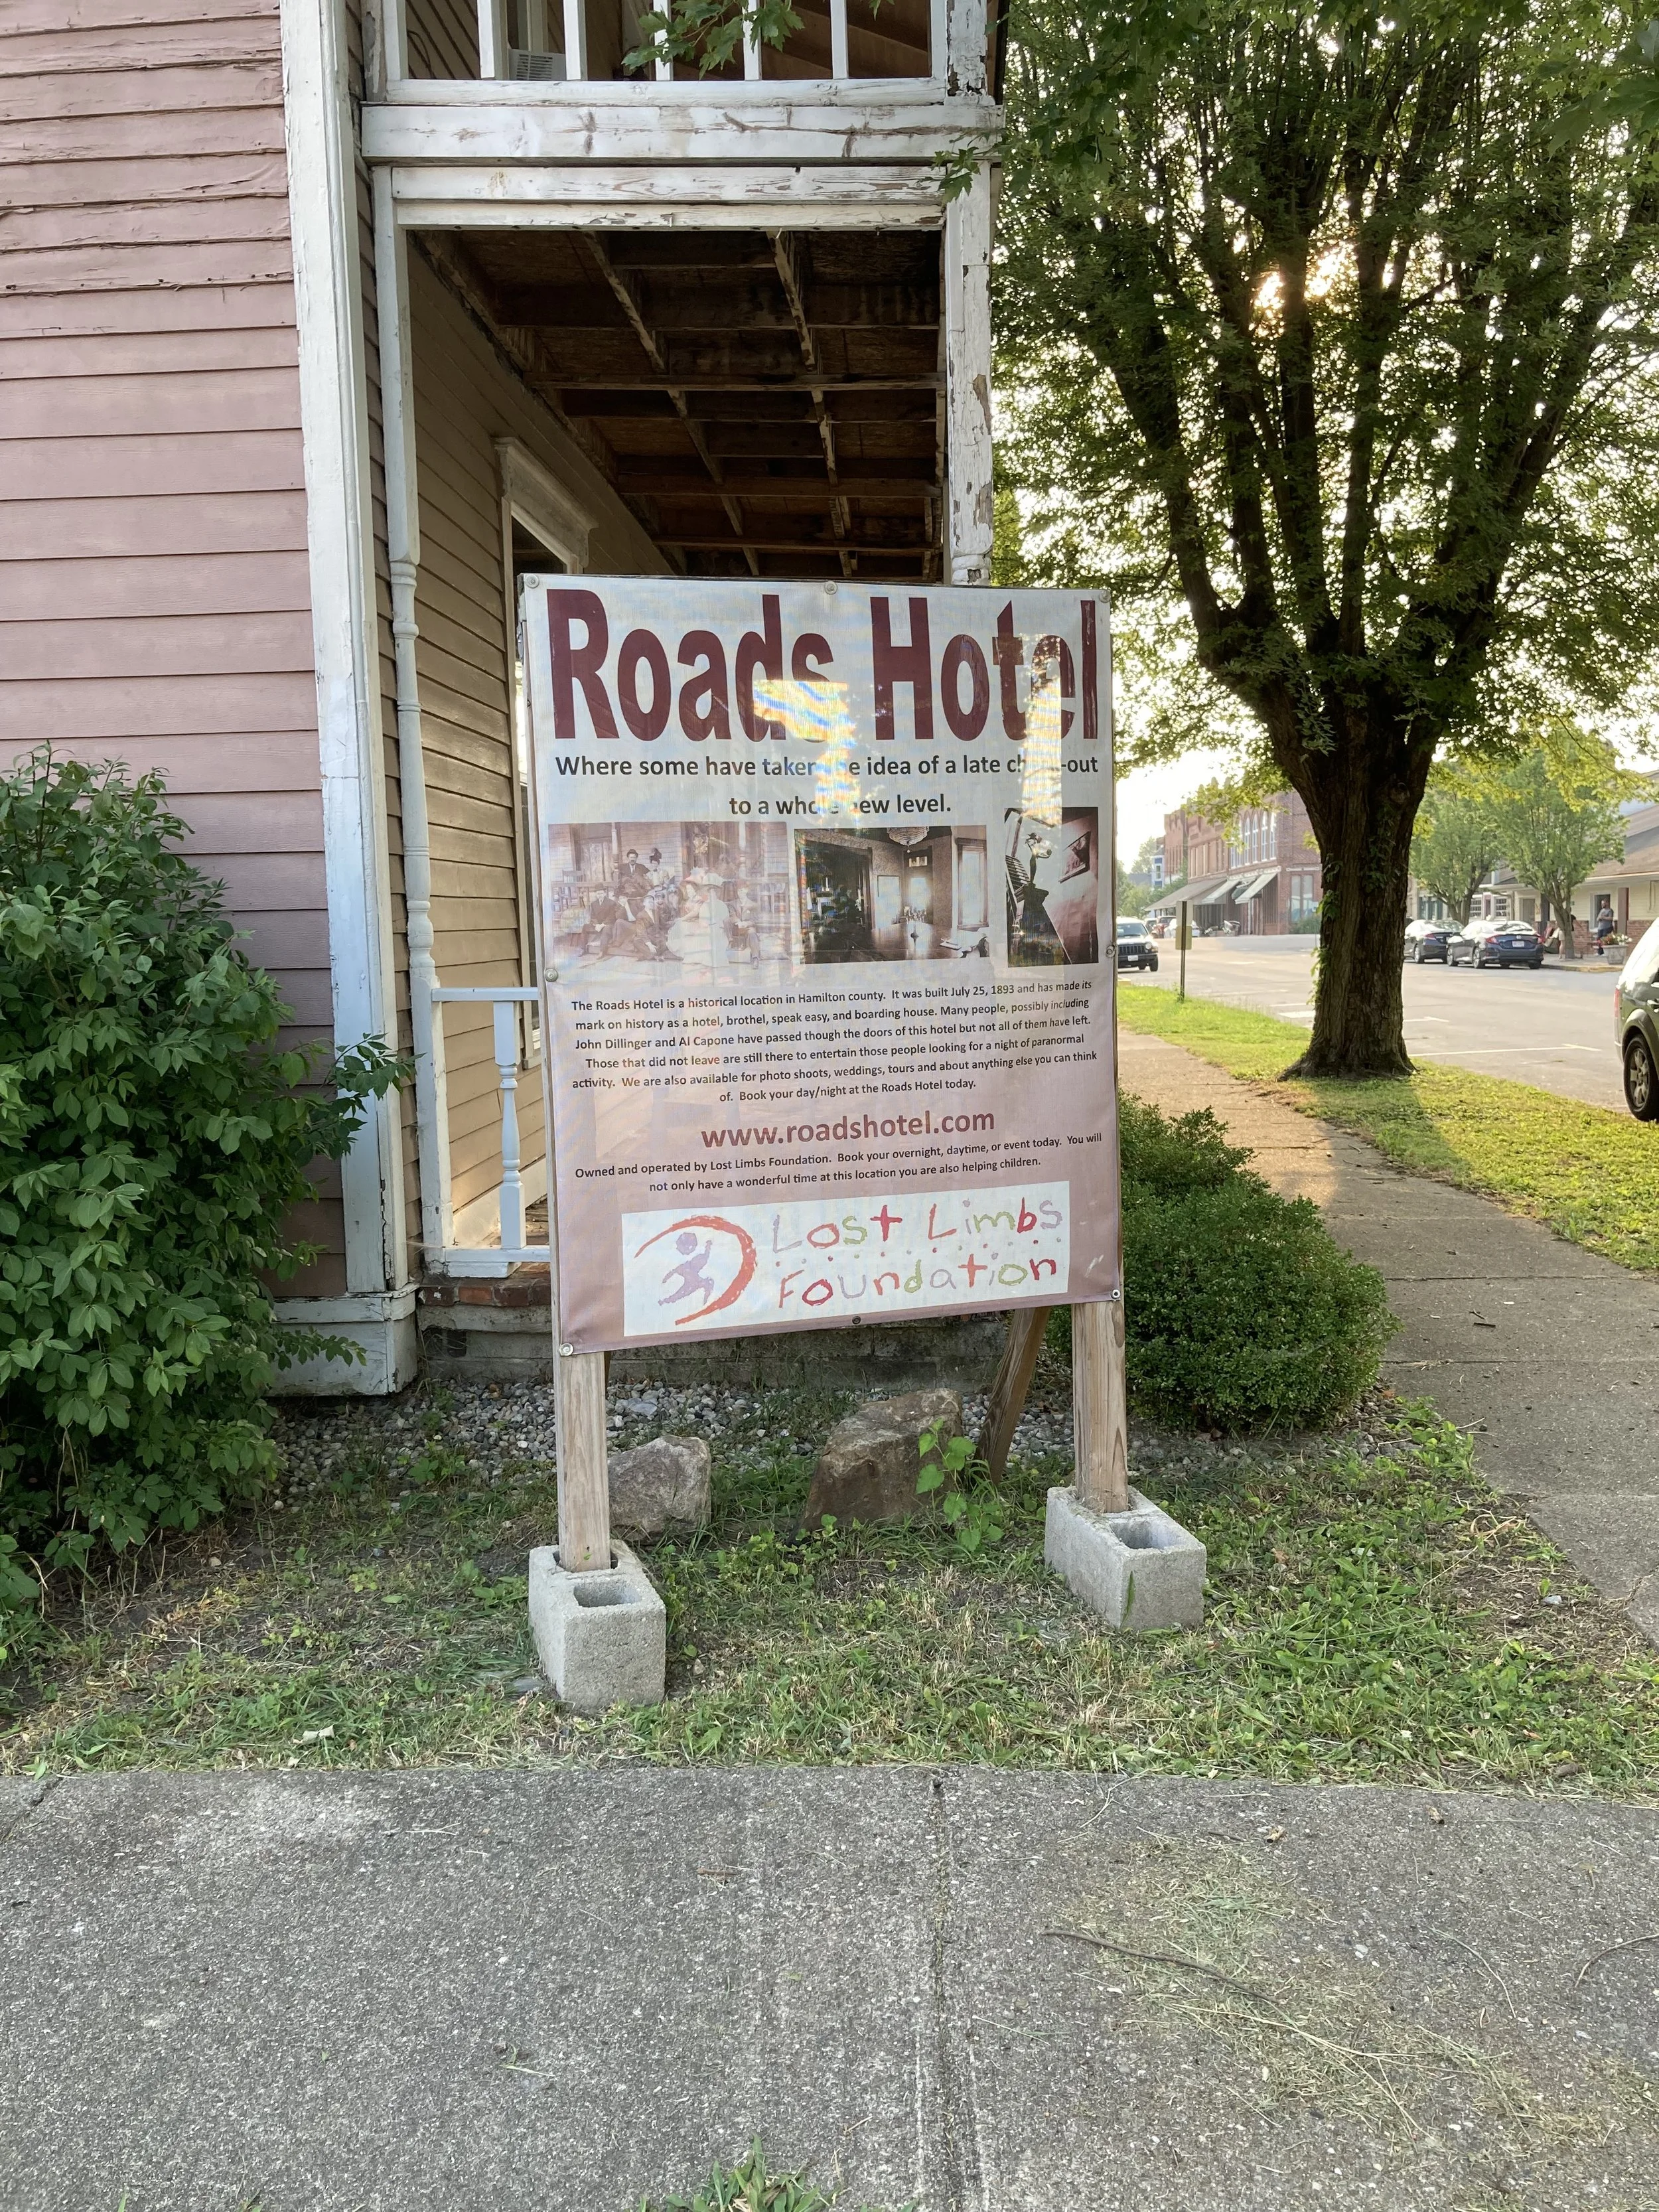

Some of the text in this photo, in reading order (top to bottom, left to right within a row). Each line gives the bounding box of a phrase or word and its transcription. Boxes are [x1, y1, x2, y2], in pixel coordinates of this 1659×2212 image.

[870, 596, 1098, 741] Hotel
[555, 755, 632, 775] Where
[639, 759, 699, 775] some
[705, 755, 756, 775] have
[867, 755, 911, 775] idea
[918, 755, 939, 774] of
[945, 760, 956, 774] a
[964, 754, 1001, 773] late
[1007, 754, 1099, 773] ch-out
[729, 798, 751, 815] to
[758, 800, 770, 815] a
[847, 798, 890, 814] ew
[897, 793, 952, 813] level.
[571, 1001, 593, 1011] The
[596, 999, 630, 1010] Roads
[634, 999, 664, 1009] Hotel
[666, 999, 676, 1009] is
[688, 995, 737, 1007] historical
[741, 995, 783, 1005] location
[786, 994, 795, 1003] in
[798, 992, 845, 1003] Hamilton
[848, 991, 886, 1002] county.
[892, 990, 900, 999] It
[925, 987, 948, 997] built
[950, 986, 970, 998] July
[973, 986, 988, 997] 25,
[991, 984, 1015, 995] 1893
[1017, 982, 1035, 994] and
[1037, 982, 1053, 992] has
[1056, 980, 1080, 991] made
[1082, 981, 1092, 990] its
[575, 1019, 605, 1030] mark
[625, 1019, 664, 1031] history
[692, 1015, 723, 1027] hotel,
[727, 1013, 769, 1025] brothel,
[772, 1012, 802, 1025] speak
[804, 1013, 830, 1023] easy,
[832, 1010, 851, 1021] and
[855, 1008, 901, 1020] boarding
[903, 1007, 938, 1017] house.
[940, 1005, 969, 1017] Many
[972, 1003, 1008, 1016] people,
[1011, 1000, 1049, 1014] possibly
[1051, 997, 1090, 1009] including
[575, 1015, 1091, 1050] John Dillinger and Al Capone have passed though the doors of this hotel but not all of them have left.
[585, 1058, 619, 1069] Those
[622, 1057, 646, 1068] that
[648, 1056, 666, 1067] did
[670, 1057, 688, 1066] not
[691, 1055, 720, 1065] leave
[743, 1052, 762, 1063] still
[764, 1051, 794, 1062] there
[796, 1051, 807, 1060] to
[810, 1047, 857, 1059] entertain
[859, 1047, 888, 1057] those
[891, 1044, 926, 1057] people
[929, 1042, 966, 1053] looking
[968, 1041, 983, 1051] for
[994, 1039, 1019, 1051] night
[1021, 1037, 1031, 1048] of
[1031, 1033, 1084, 1049] paranormal
[572, 1077, 615, 1089] activity.
[621, 1077, 640, 1086] We
[664, 1074, 687, 1086] also
[690, 1072, 739, 1084] available
[741, 1072, 757, 1082] for
[759, 1070, 791, 1083] photo
[794, 1069, 831, 1079] shoots,
[833, 1065, 885, 1076] weddings,
[887, 1065, 914, 1074] tours
[917, 1061, 936, 1072] and
[939, 1061, 970, 1071] about
[972, 1058, 1013, 1070] anything
[1015, 1056, 1033, 1066] else
[1035, 1056, 1051, 1066] you
[1072, 1051, 1097, 1061] think
[719, 1078, 976, 1102] of. Book your day/night at the Roads Hotel today.
[701, 1110, 995, 1148] www.roadshotel.com
[575, 1165, 615, 1178] Owned
[618, 1163, 638, 1175] and
[640, 1161, 691, 1175] operated
[694, 1161, 707, 1173] by
[710, 1161, 733, 1171] Lost
[735, 1157, 766, 1169] Limbs
[769, 1154, 831, 1167] Foundation.
[837, 1151, 864, 1162] Book
[866, 1151, 890, 1163] your
[893, 1146, 944, 1159] overnight,
[946, 1144, 989, 1156] daytime,
[1003, 1140, 1031, 1150] event
[1032, 1137, 1062, 1148] today.
[1066, 1136, 1084, 1145] You
[1086, 1132, 1102, 1143] will
[649, 1182, 668, 1192] not
[671, 1180, 695, 1192] only
[697, 1179, 724, 1189] have
[735, 1174, 790, 1187] wonderful
[793, 1173, 818, 1183] time
[820, 1173, 831, 1181] at
[833, 1170, 853, 1181] this
[855, 1168, 896, 1179] location
[899, 1168, 917, 1179] you
[939, 1163, 960, 1173] also
[962, 1161, 998, 1173] helping
[999, 1157, 1041, 1169] children.
[771, 1197, 1063, 1254] Lost Limbs
[778, 1252, 1057, 1308] Foundation
